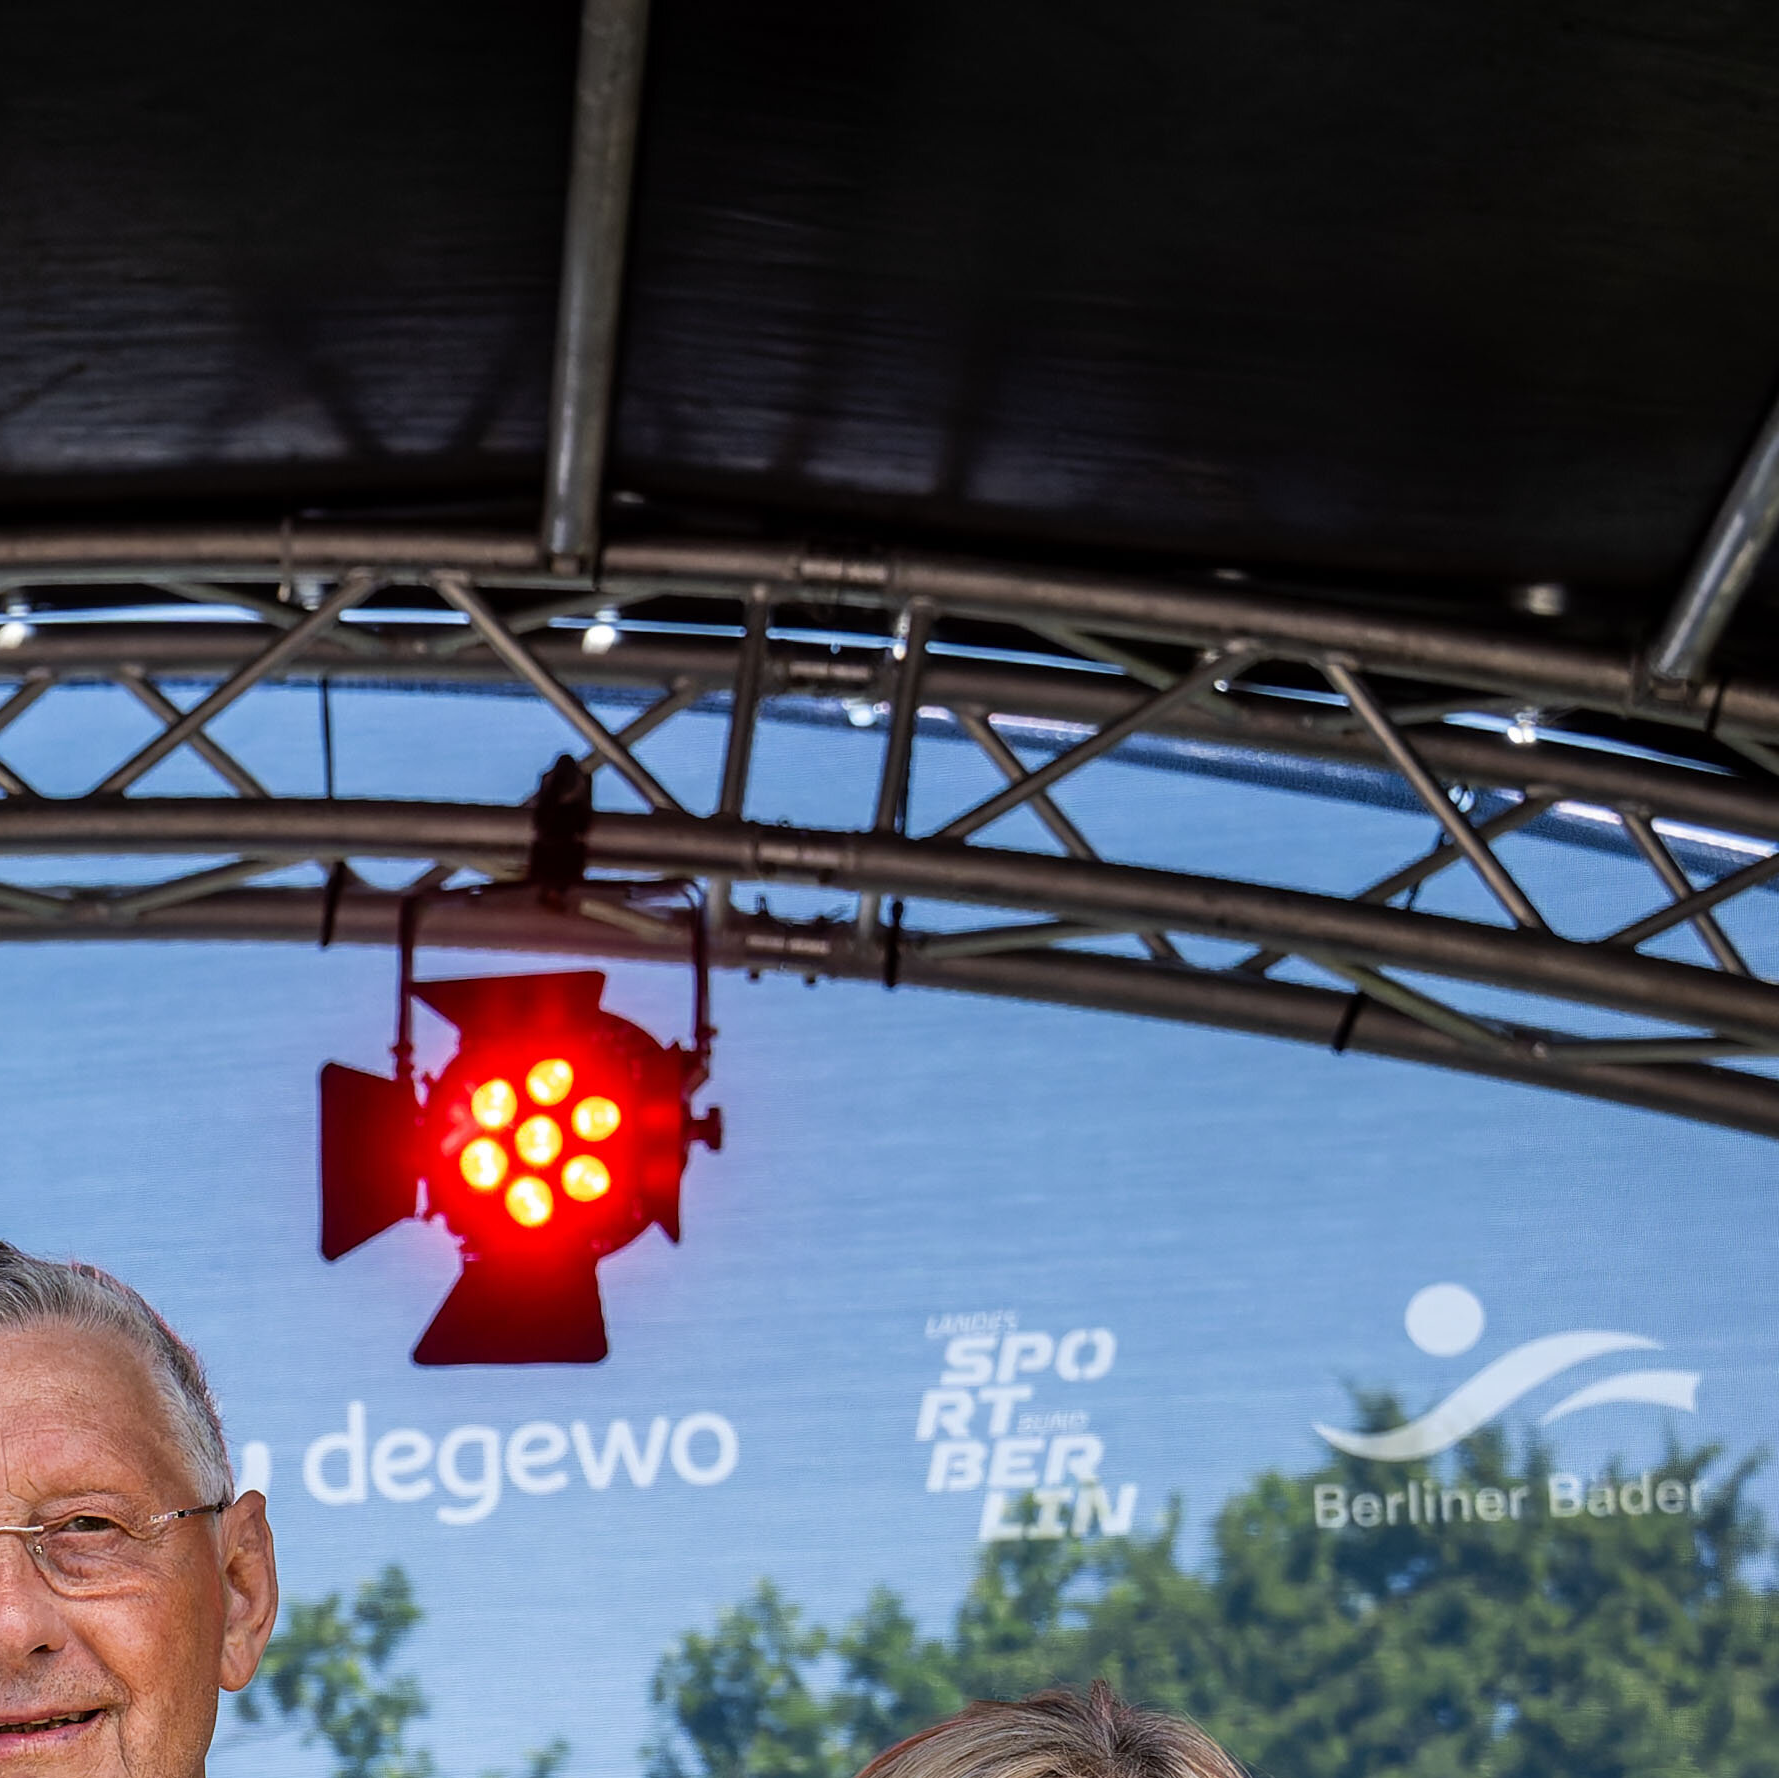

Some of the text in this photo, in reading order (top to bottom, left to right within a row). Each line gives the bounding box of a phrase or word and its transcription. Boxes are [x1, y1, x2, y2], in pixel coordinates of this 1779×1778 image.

[940, 1327, 1116, 1386] SPO
[916, 1384, 1034, 1441] RT
[303, 1400, 740, 1525] degewo
[926, 1433, 1105, 1493] BER
[978, 1482, 1139, 1542] LIN
[1314, 1471, 1707, 1529] Berliner Bäder
